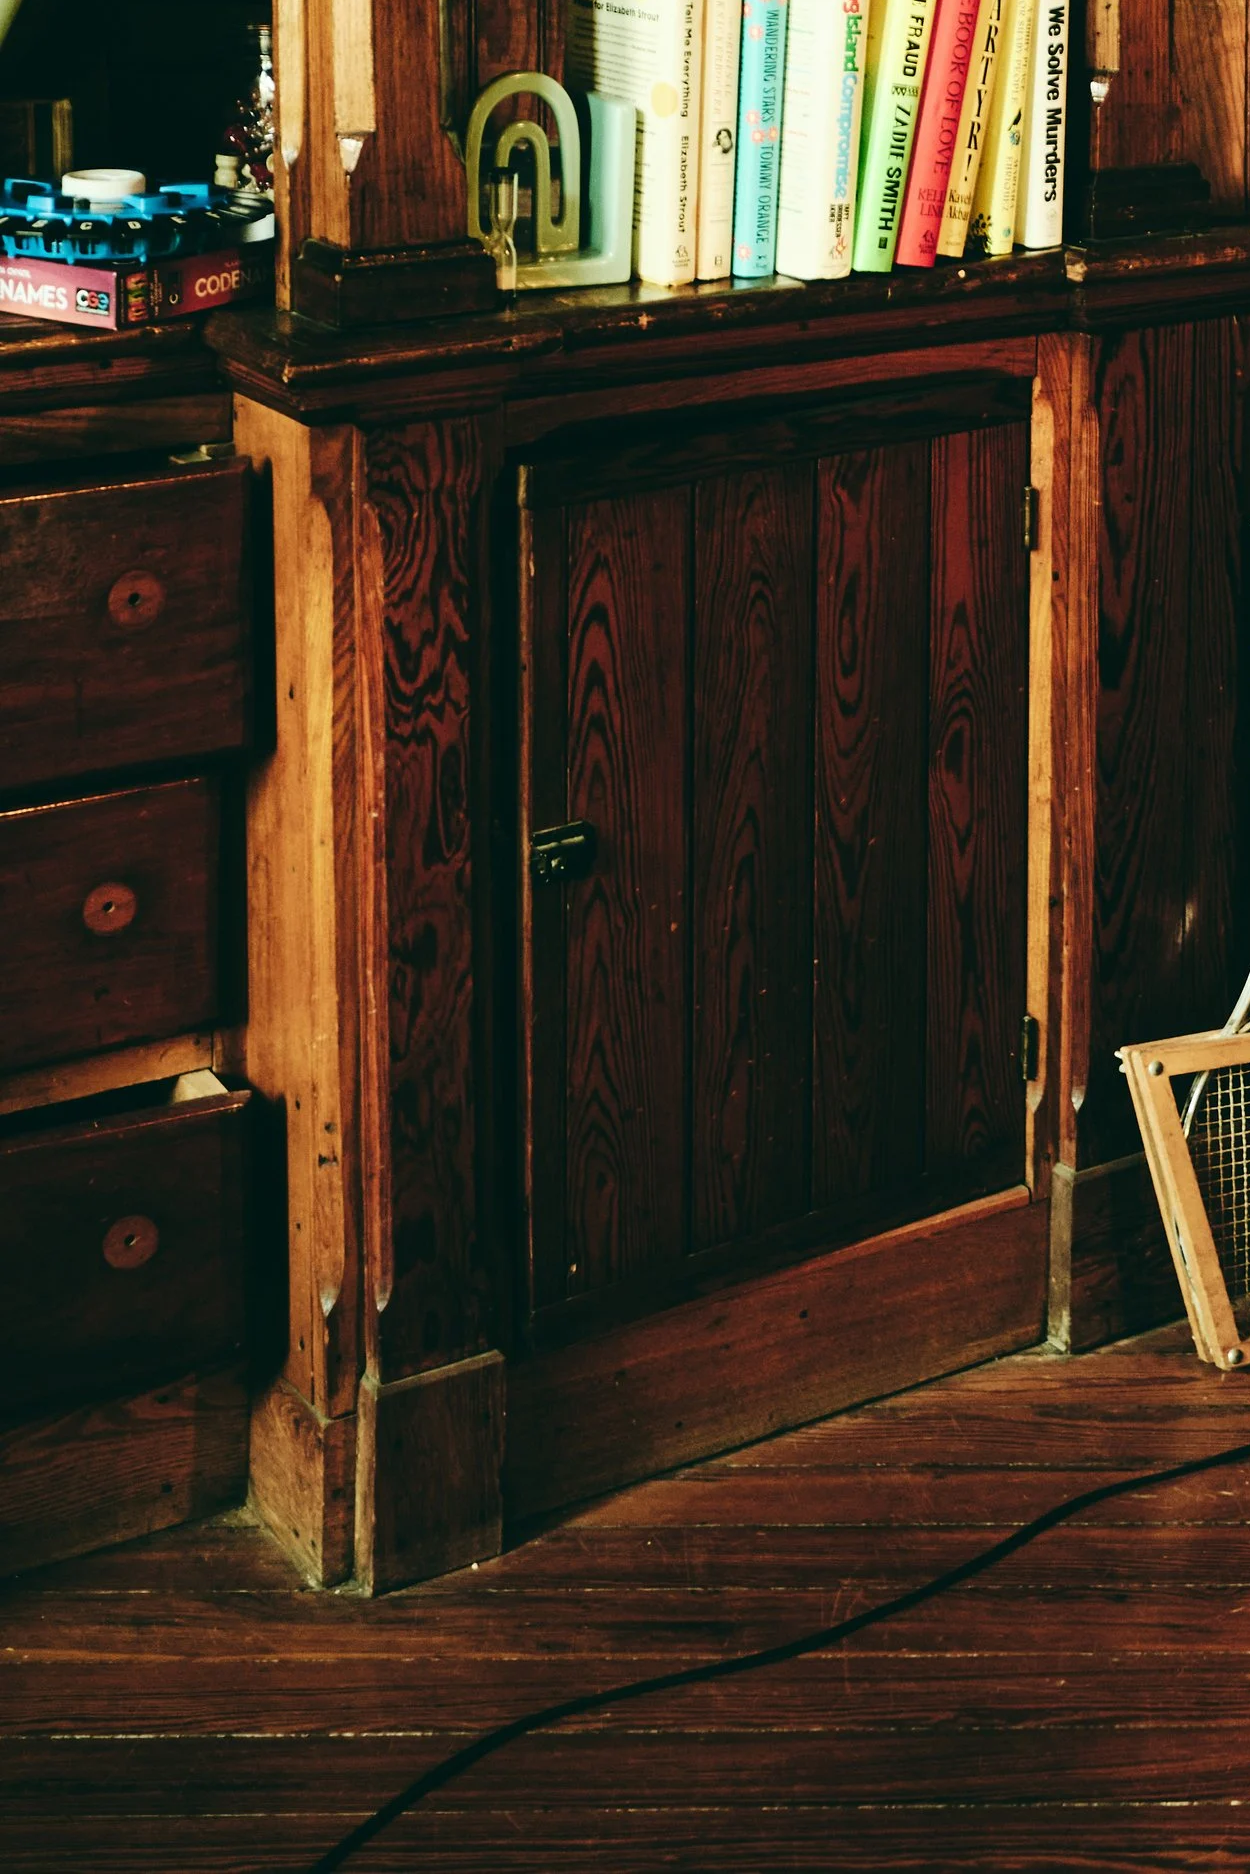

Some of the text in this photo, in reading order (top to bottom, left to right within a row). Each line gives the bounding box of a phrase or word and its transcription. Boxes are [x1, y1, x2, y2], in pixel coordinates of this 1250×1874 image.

[593, 0, 604, 10] for
[606, 2, 636, 18] Elizabeth
[637, 8, 660, 22] Strout
[950, 11, 974, 73] BOOK
[760, 8, 780, 124] WANDERING STARS
[843, 13, 863, 73] Island
[902, 15, 925, 78] FRAUD
[677, 1, 693, 233] Tell Me Everything Elizabeth Strout
[944, 76, 960, 106] OF
[1044, 5, 1065, 203] We Solve Murders
[758, 142, 775, 191] TOMMY
[833, 72, 858, 200] Compromise
[933, 111, 957, 175] LOVE
[878, 103, 912, 232] ZADIE SMITH
[918, 187, 945, 202] KELL
[755, 195, 772, 245] ORANGE
